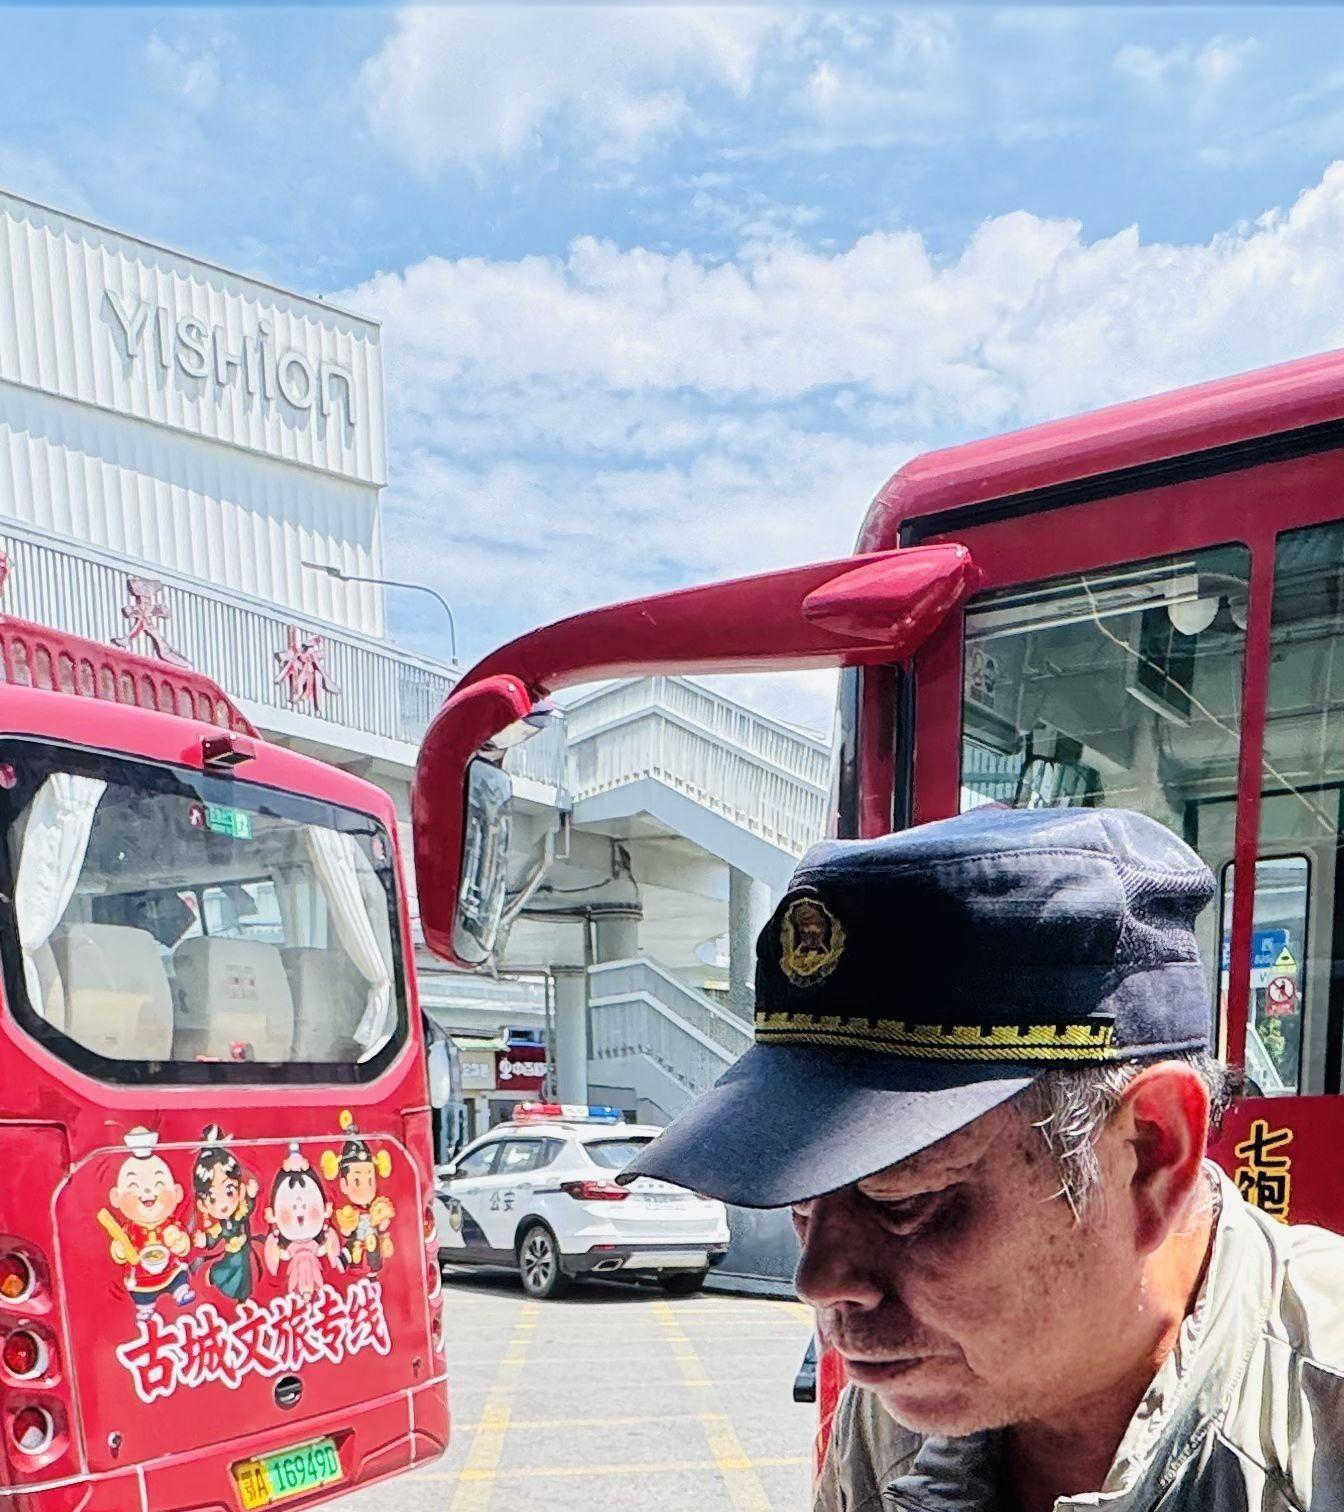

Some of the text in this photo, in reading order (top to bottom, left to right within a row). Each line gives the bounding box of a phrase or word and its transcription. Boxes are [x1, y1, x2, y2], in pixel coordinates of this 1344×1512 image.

[489, 1189, 517, 1213] 公安
[116, 1278, 391, 1403] 古城文旅专线
